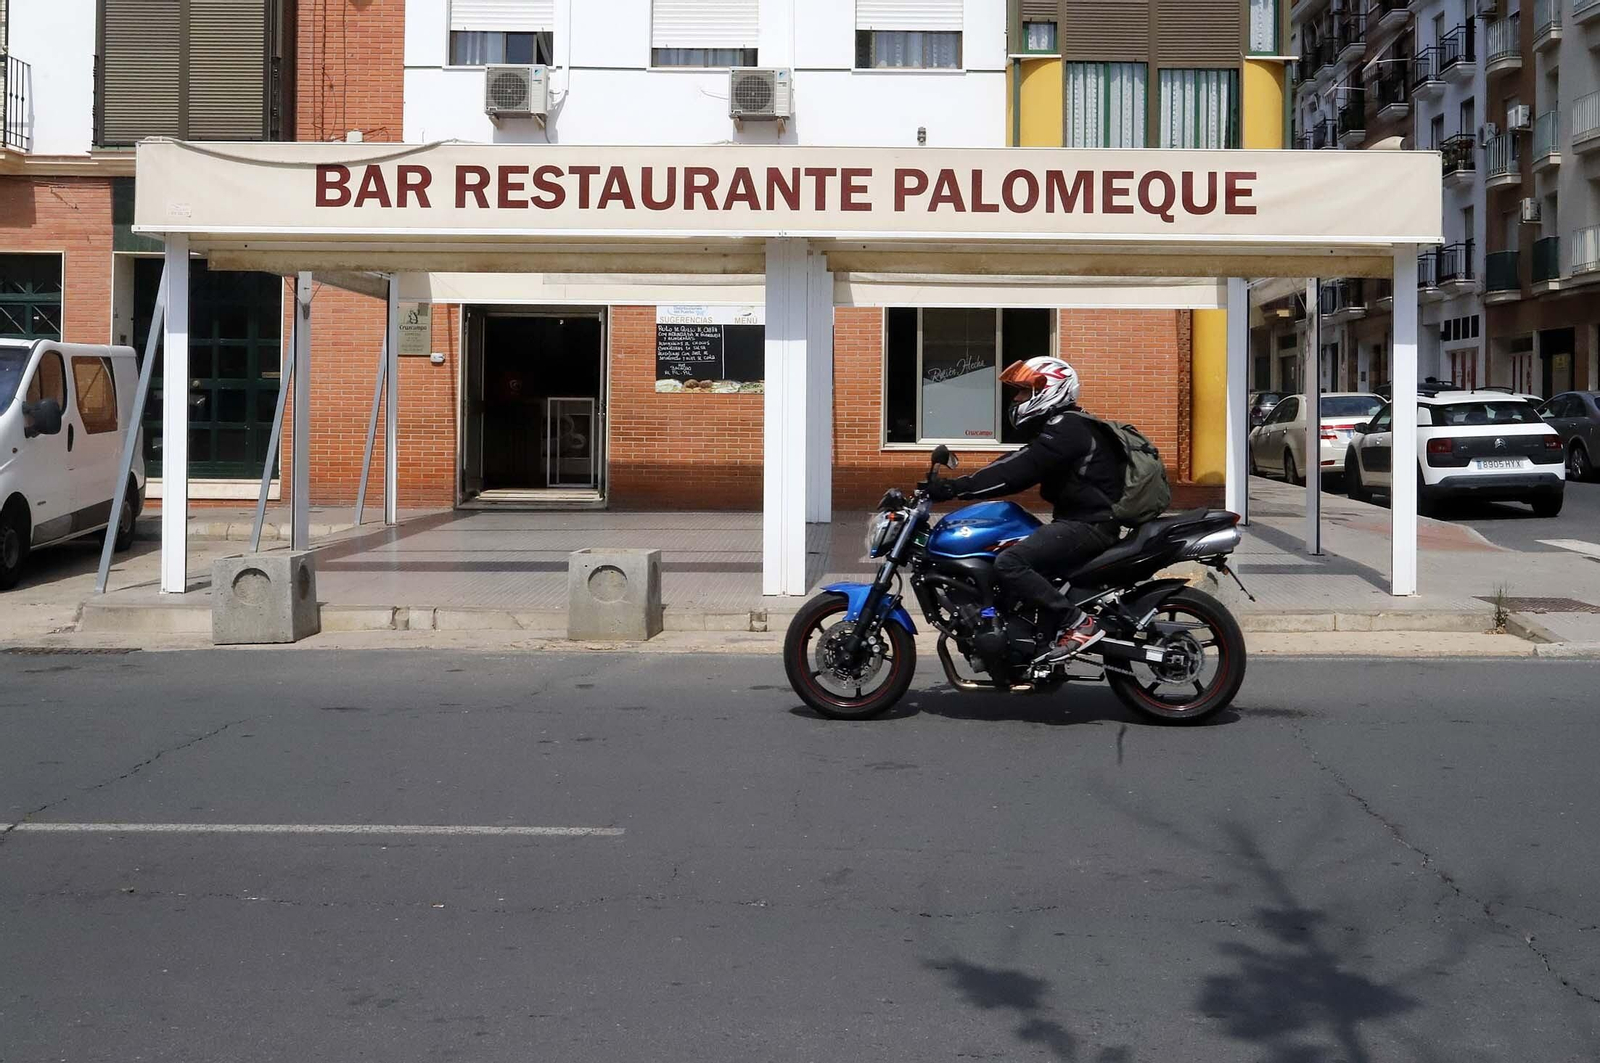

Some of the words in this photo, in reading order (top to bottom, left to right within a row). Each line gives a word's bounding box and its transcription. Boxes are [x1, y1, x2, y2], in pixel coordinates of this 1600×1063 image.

[315, 164, 432, 209] BAR
[454, 165, 873, 212] RESTAURANTE
[894, 168, 1258, 224] PALOMEQUE
[659, 316, 713, 324] SUGERENCIAS
[964, 429, 993, 437] Cruzcampo
